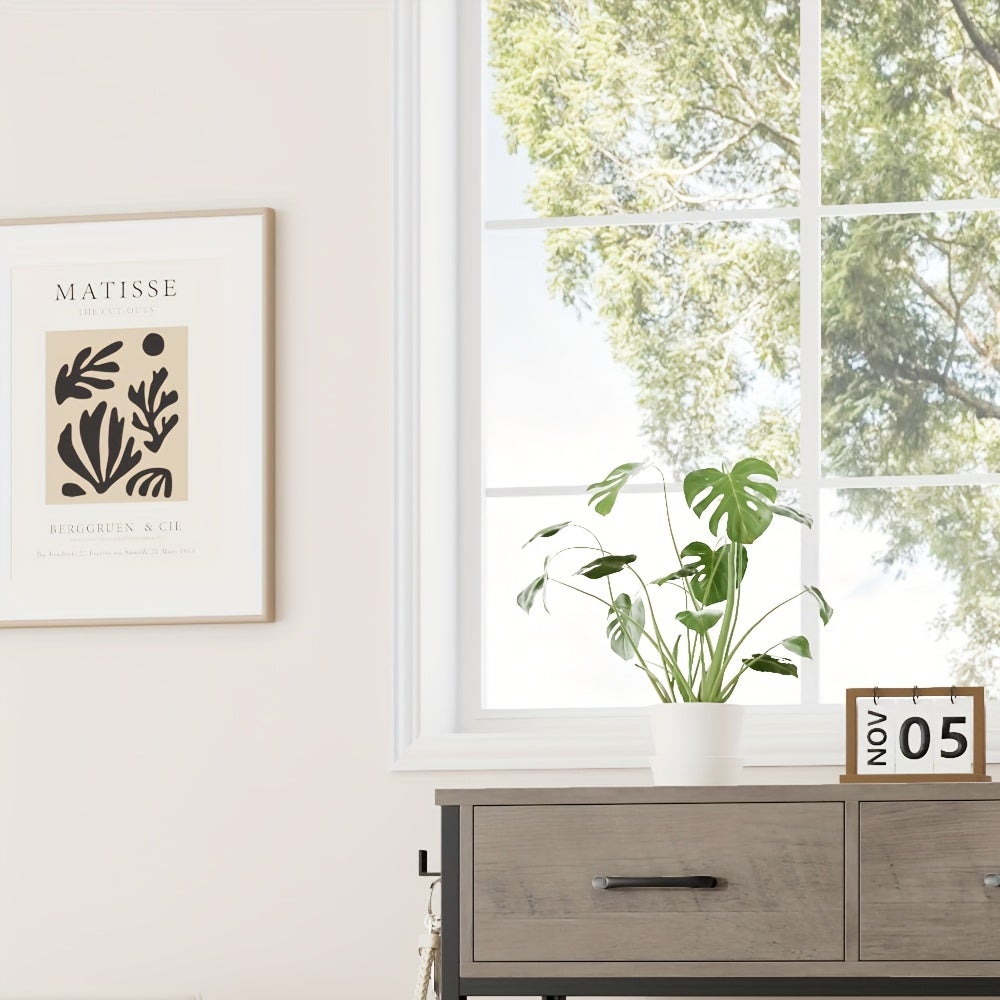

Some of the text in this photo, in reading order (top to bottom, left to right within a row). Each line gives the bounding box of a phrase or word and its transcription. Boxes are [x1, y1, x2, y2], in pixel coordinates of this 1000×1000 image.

[55, 279, 176, 301] MATISSE
[50, 520, 182, 535] BERGGRUEN & CIE
[867, 710, 887, 766] NOV
[899, 716, 968, 760] 05
